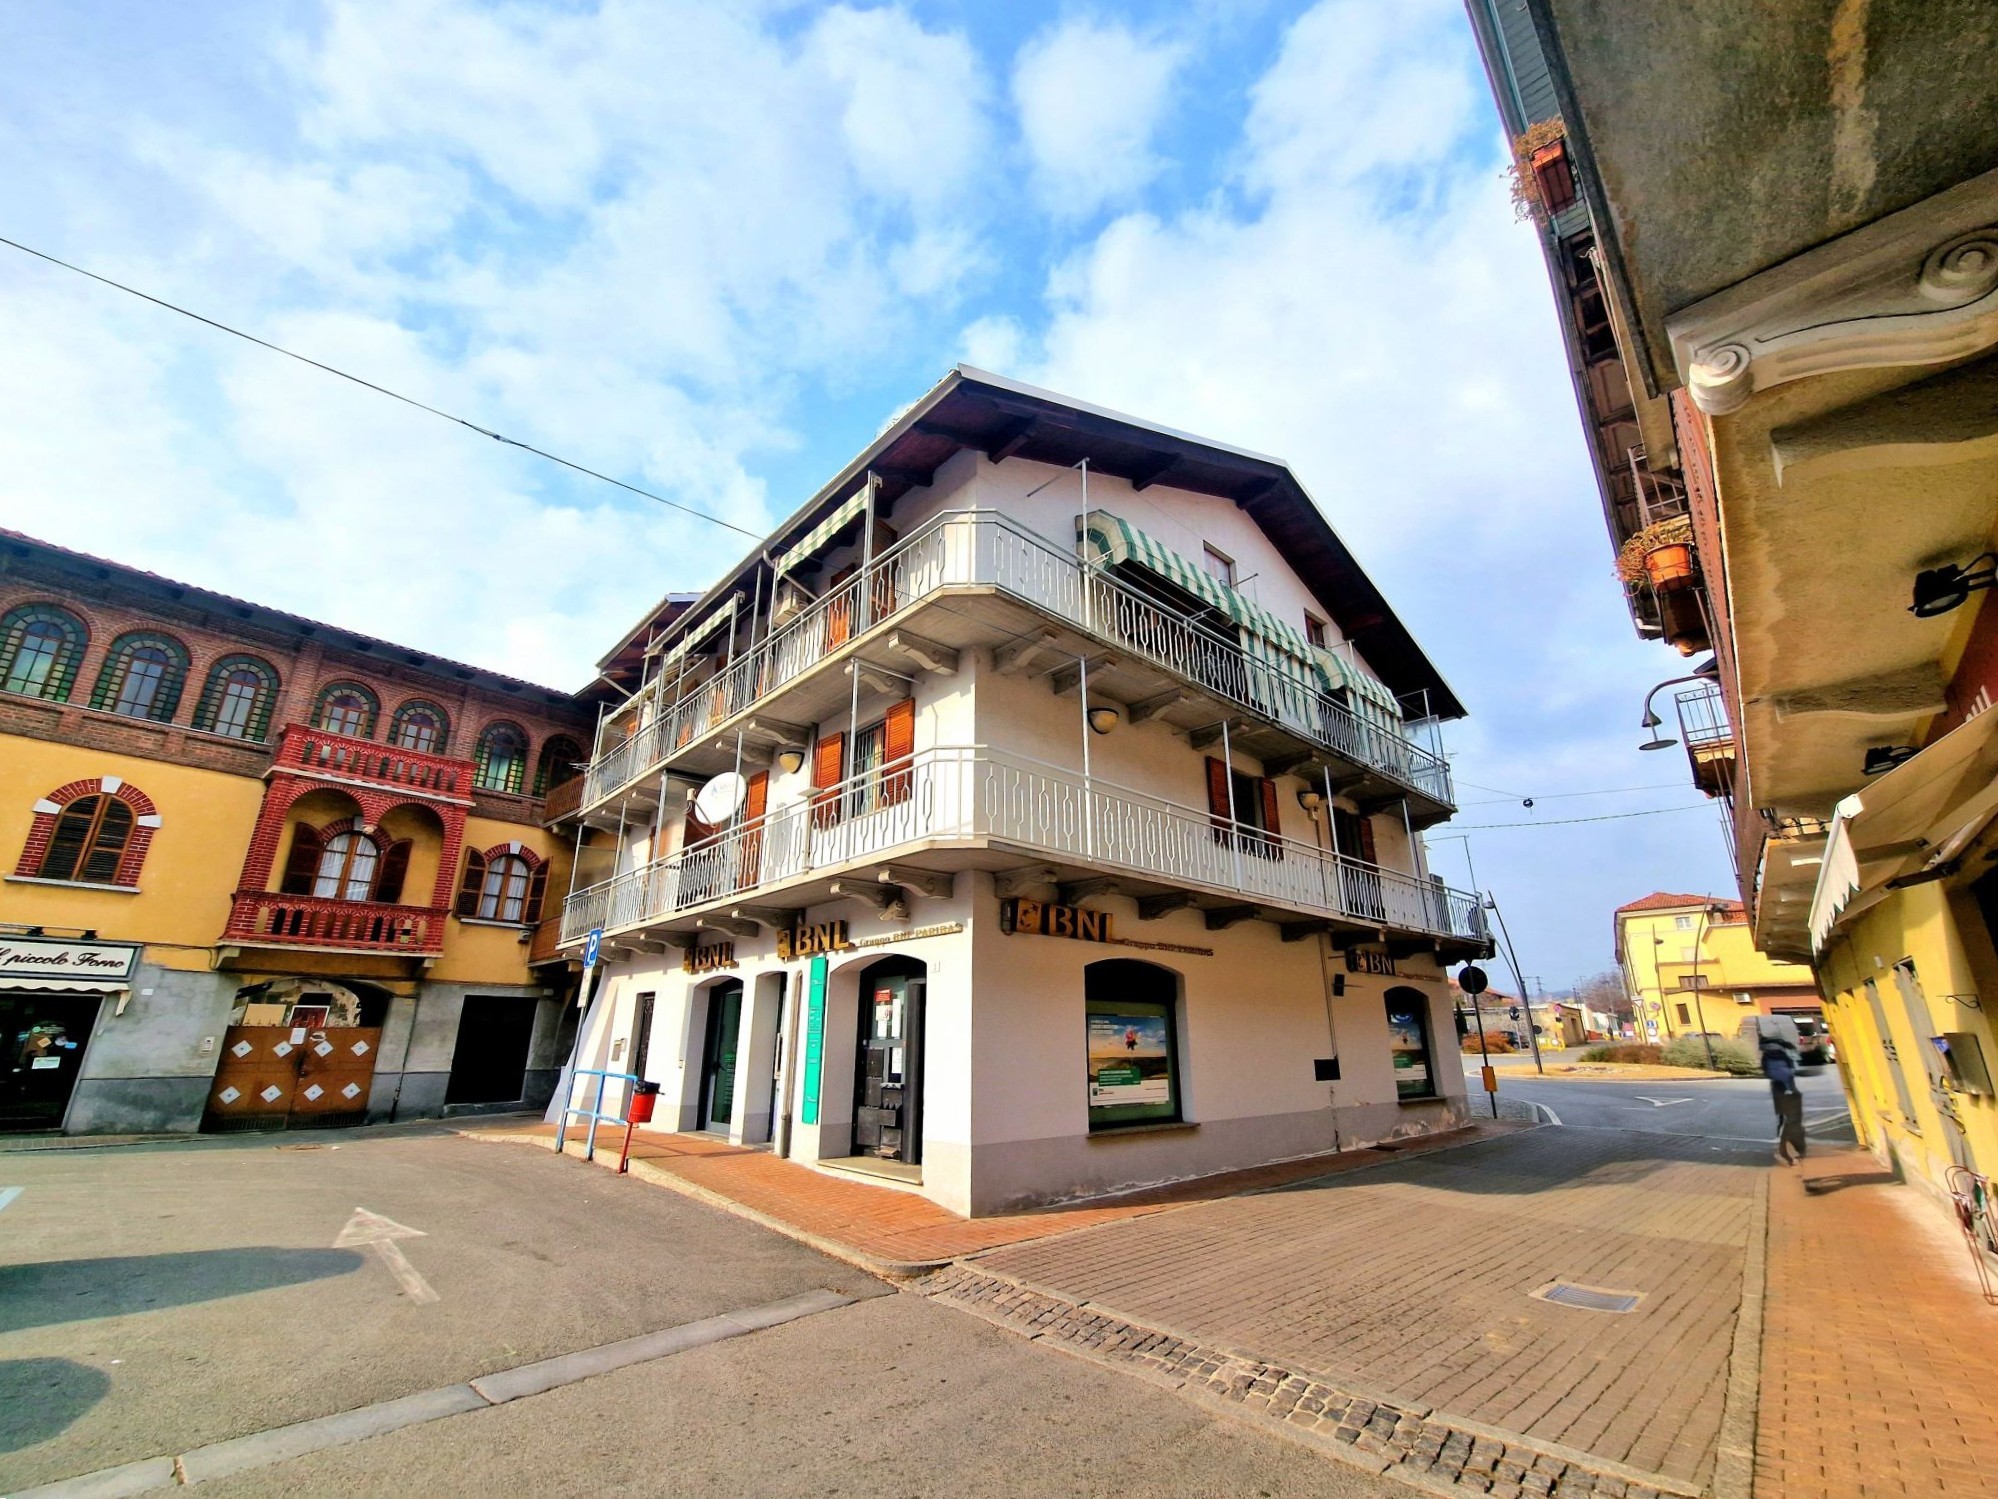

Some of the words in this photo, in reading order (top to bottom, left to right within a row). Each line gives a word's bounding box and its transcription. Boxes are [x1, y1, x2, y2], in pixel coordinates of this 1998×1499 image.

[795, 920, 849, 956] BNL
[860, 936, 890, 948] Gruppo
[915, 923, 963, 938] PARIBAS
[1050, 904, 1118, 944] BNL
[2, 951, 69, 966] piccolo
[72, 952, 125, 969] Forno
[587, 934, 598, 962] P
[695, 942, 735, 970] BNL
